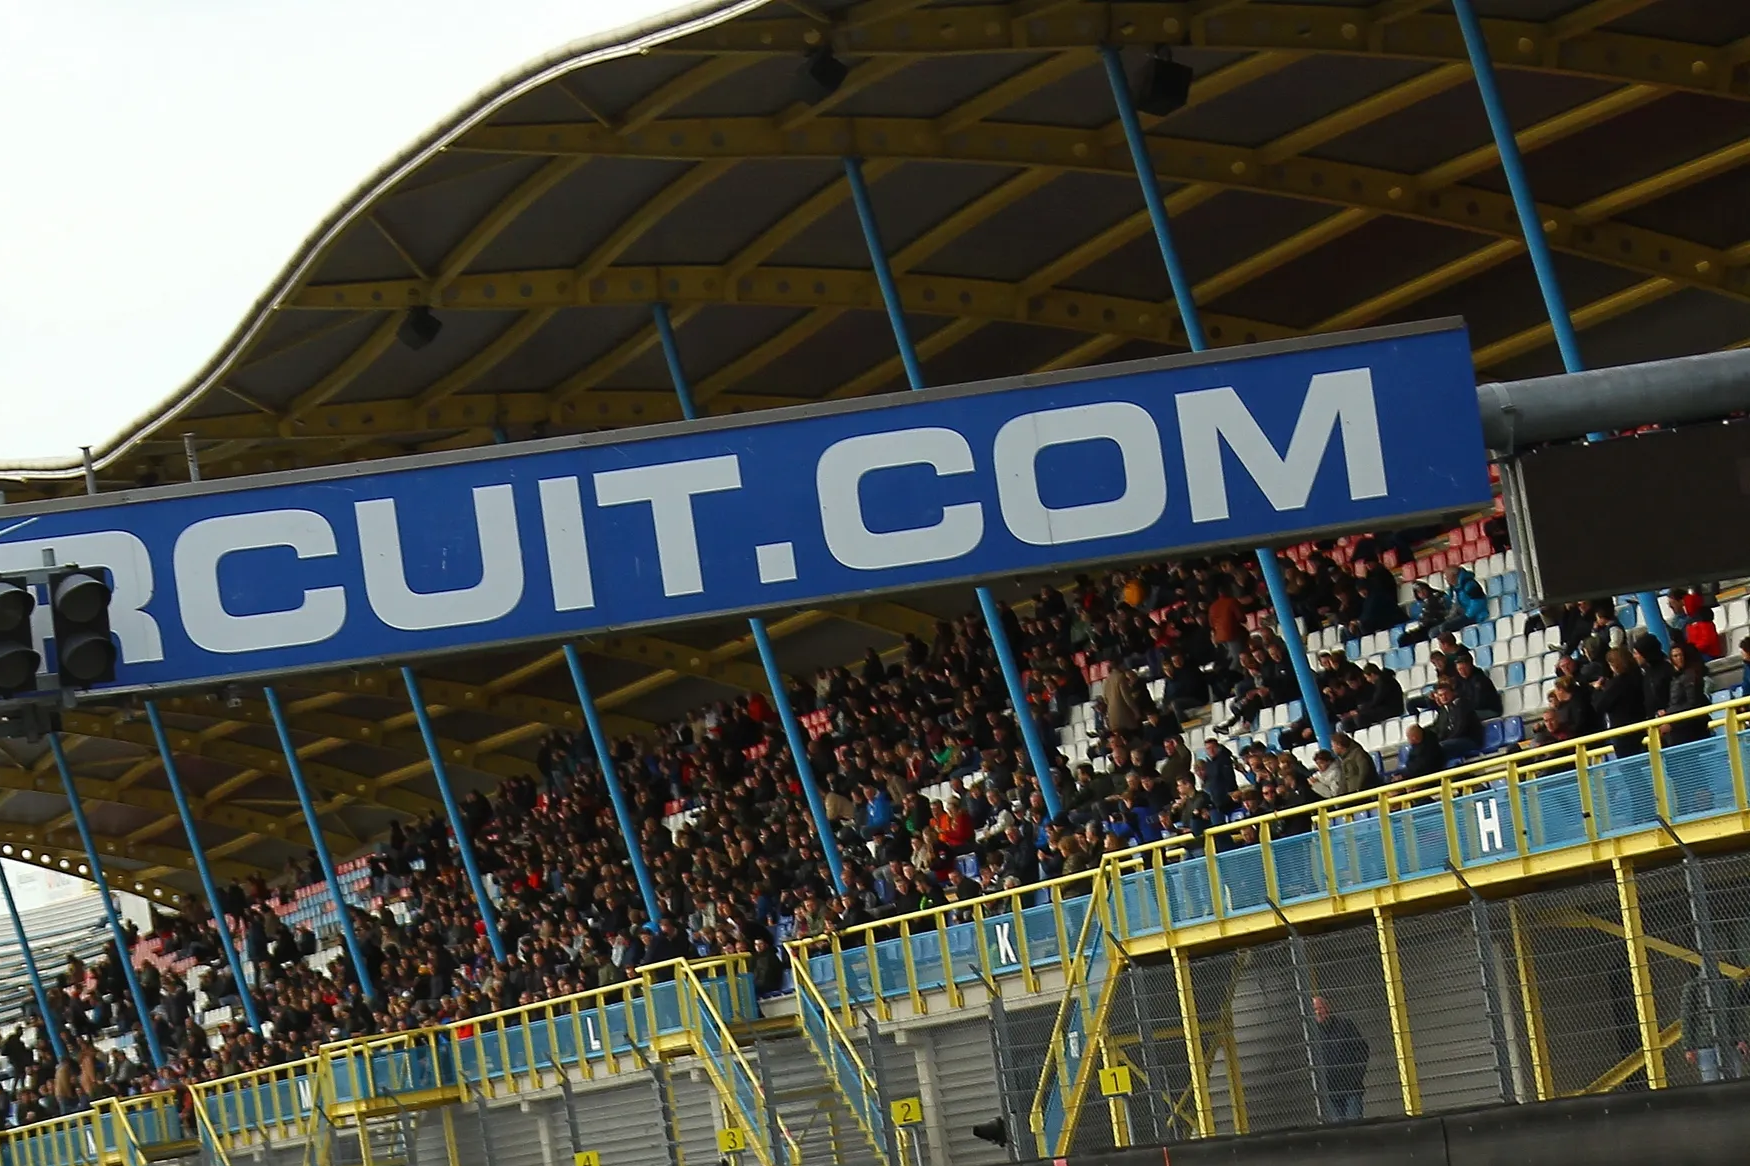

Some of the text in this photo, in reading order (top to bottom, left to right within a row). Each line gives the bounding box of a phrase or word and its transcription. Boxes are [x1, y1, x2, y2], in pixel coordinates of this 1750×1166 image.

[1475, 797, 1503, 852] H
[995, 922, 1017, 965] K
[586, 1016, 601, 1051] L
[1110, 1071, 1119, 1091] 1
[901, 1102, 913, 1121] 2
[727, 1131, 738, 1149] 3
